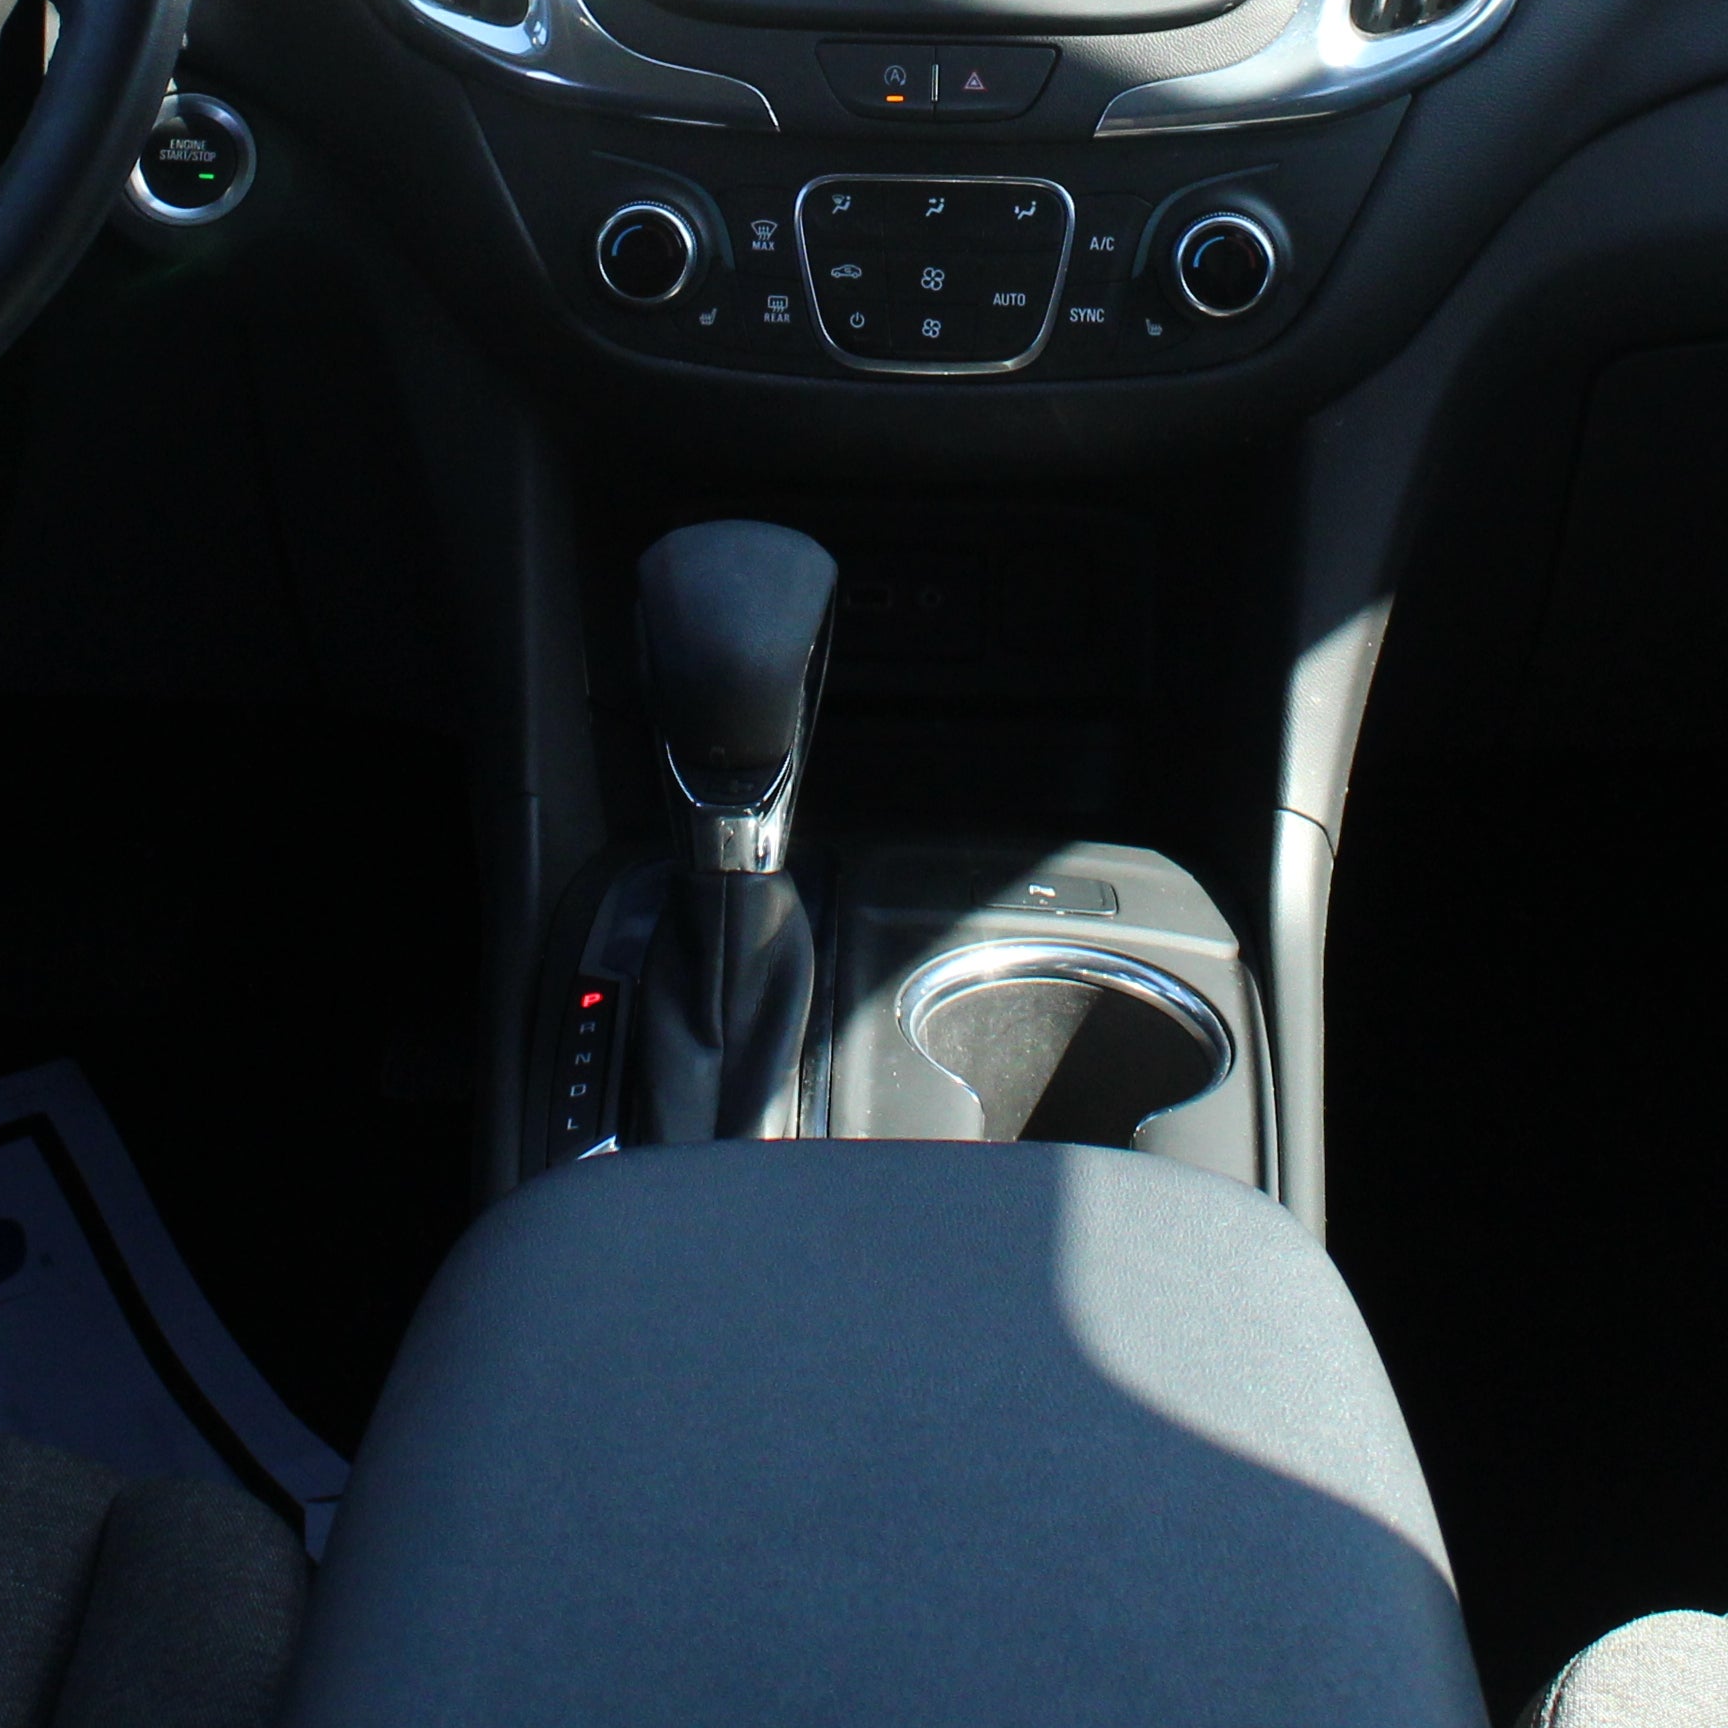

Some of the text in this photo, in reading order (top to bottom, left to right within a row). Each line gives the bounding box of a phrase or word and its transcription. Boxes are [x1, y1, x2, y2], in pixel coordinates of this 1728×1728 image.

[170, 138, 207, 150] ENGINE
[159, 149, 217, 162] START/STOP
[751, 240, 775, 251] MAX
[1089, 236, 1115, 252] A/C
[992, 292, 1027, 307] AUTO
[763, 312, 791, 323] REAR
[1069, 307, 1105, 323] SYNC
[580, 992, 603, 1008] P
[574, 1052, 592, 1065] N
[569, 1083, 587, 1097] D
